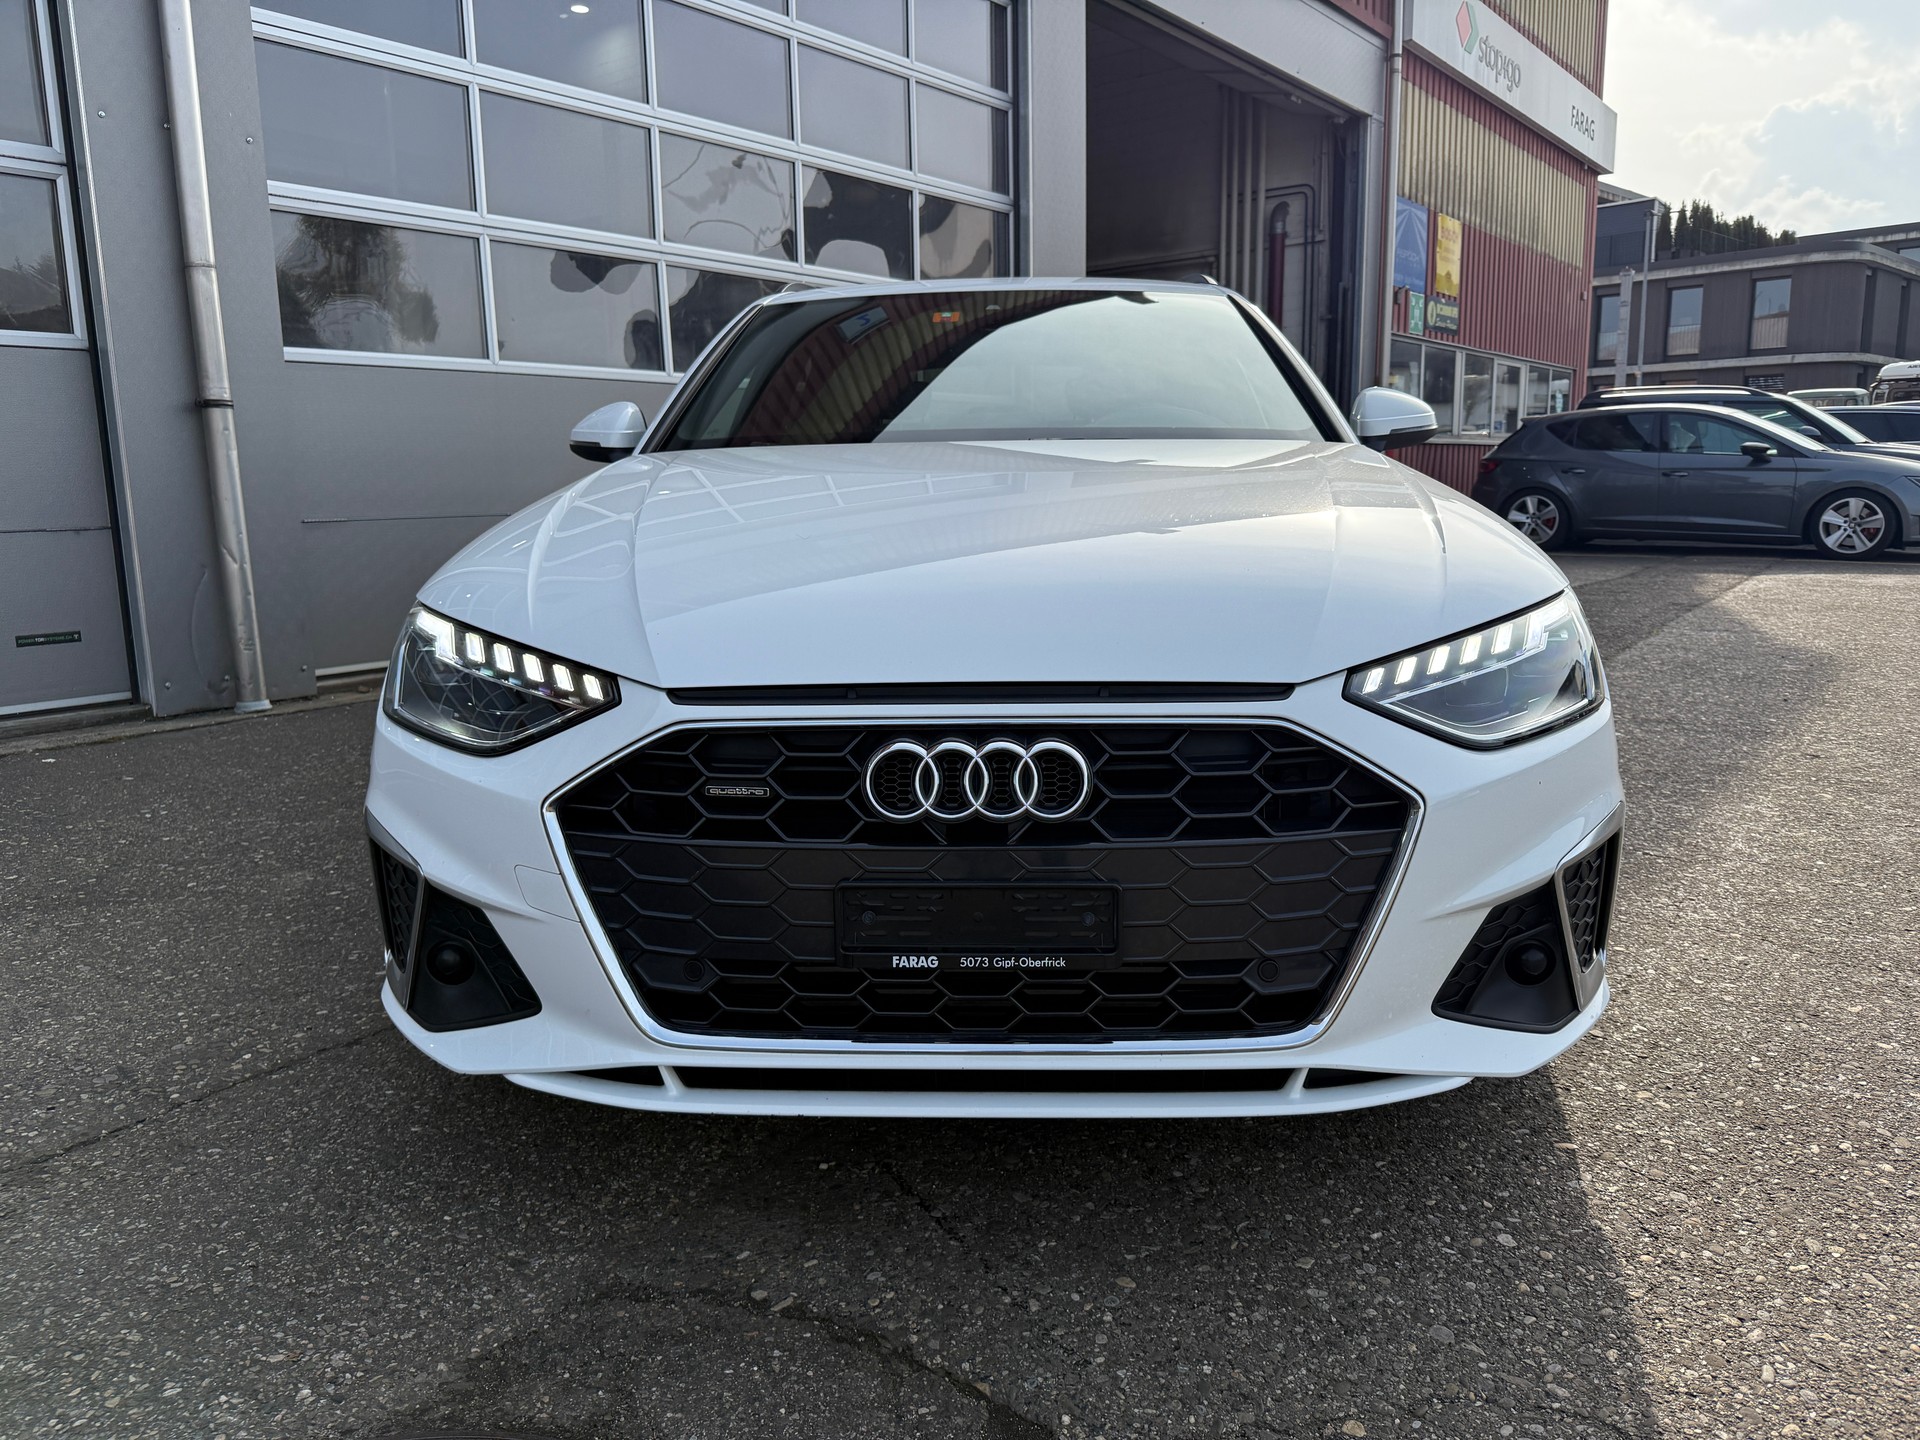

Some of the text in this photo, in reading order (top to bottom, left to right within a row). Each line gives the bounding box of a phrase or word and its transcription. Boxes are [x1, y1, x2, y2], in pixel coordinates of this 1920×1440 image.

[1570, 105, 1595, 141] FARAG
[709, 788, 764, 796] quattro
[892, 956, 1066, 969] FARAG 5073 Gipf-Oberfrick
